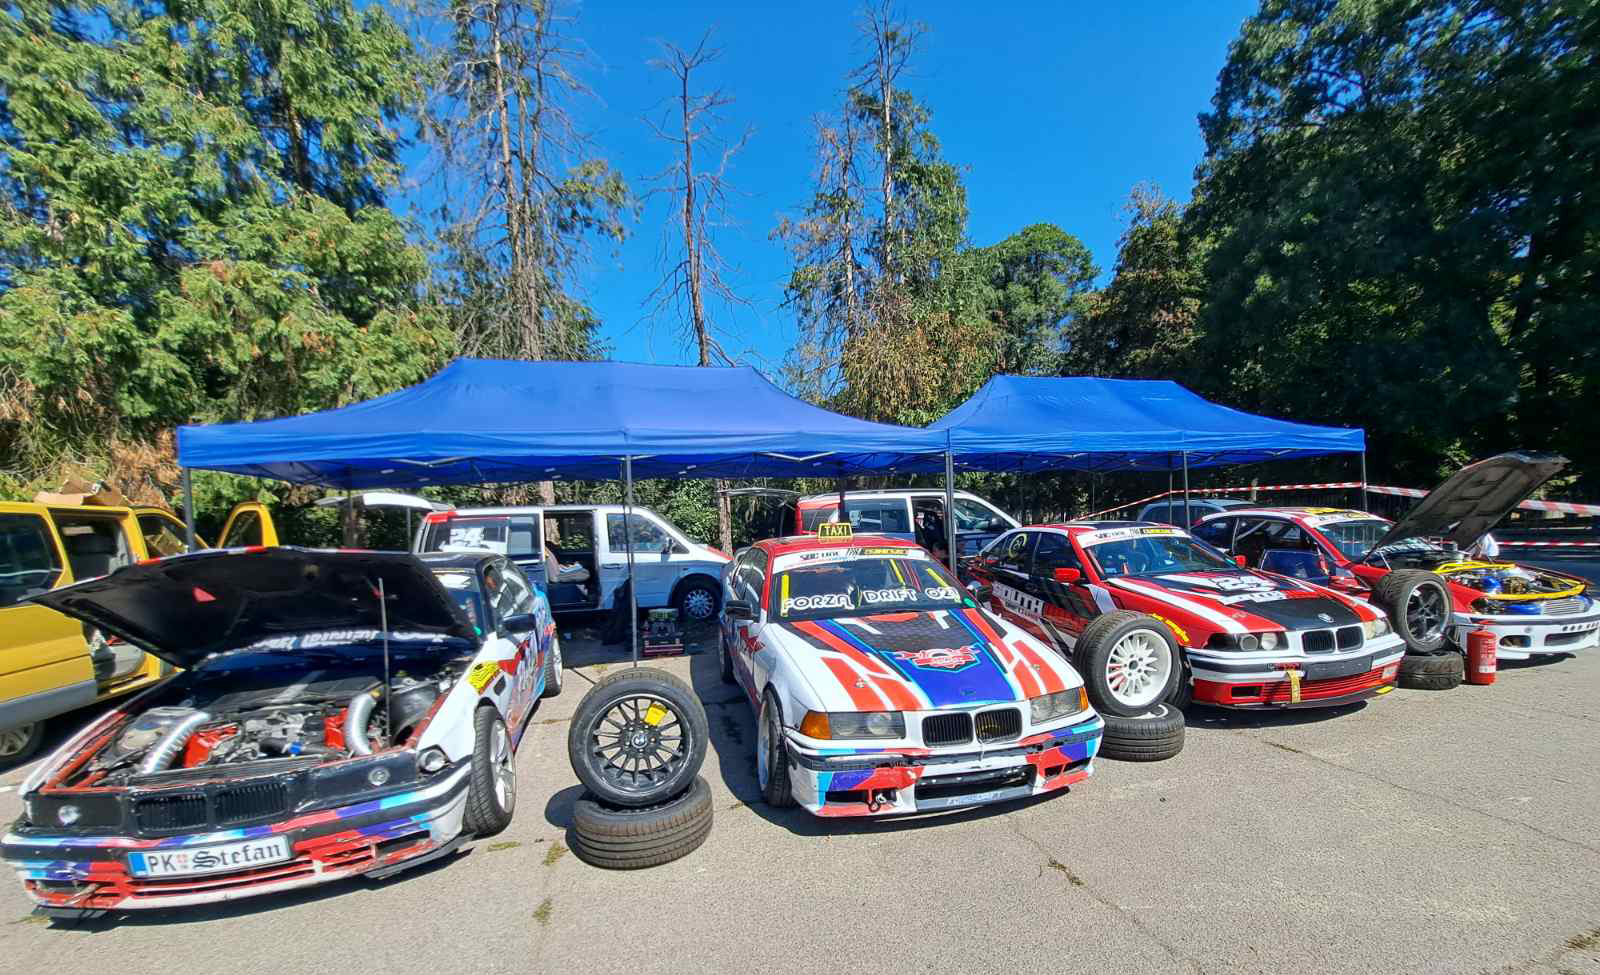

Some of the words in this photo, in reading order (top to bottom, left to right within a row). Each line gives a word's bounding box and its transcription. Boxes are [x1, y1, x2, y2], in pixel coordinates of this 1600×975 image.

[824, 525, 848, 537] TAXI
[783, 593, 854, 612] FORZA
[863, 589, 917, 604] DRIFT
[148, 854, 177, 873] PK
[192, 844, 281, 867] Stefan
